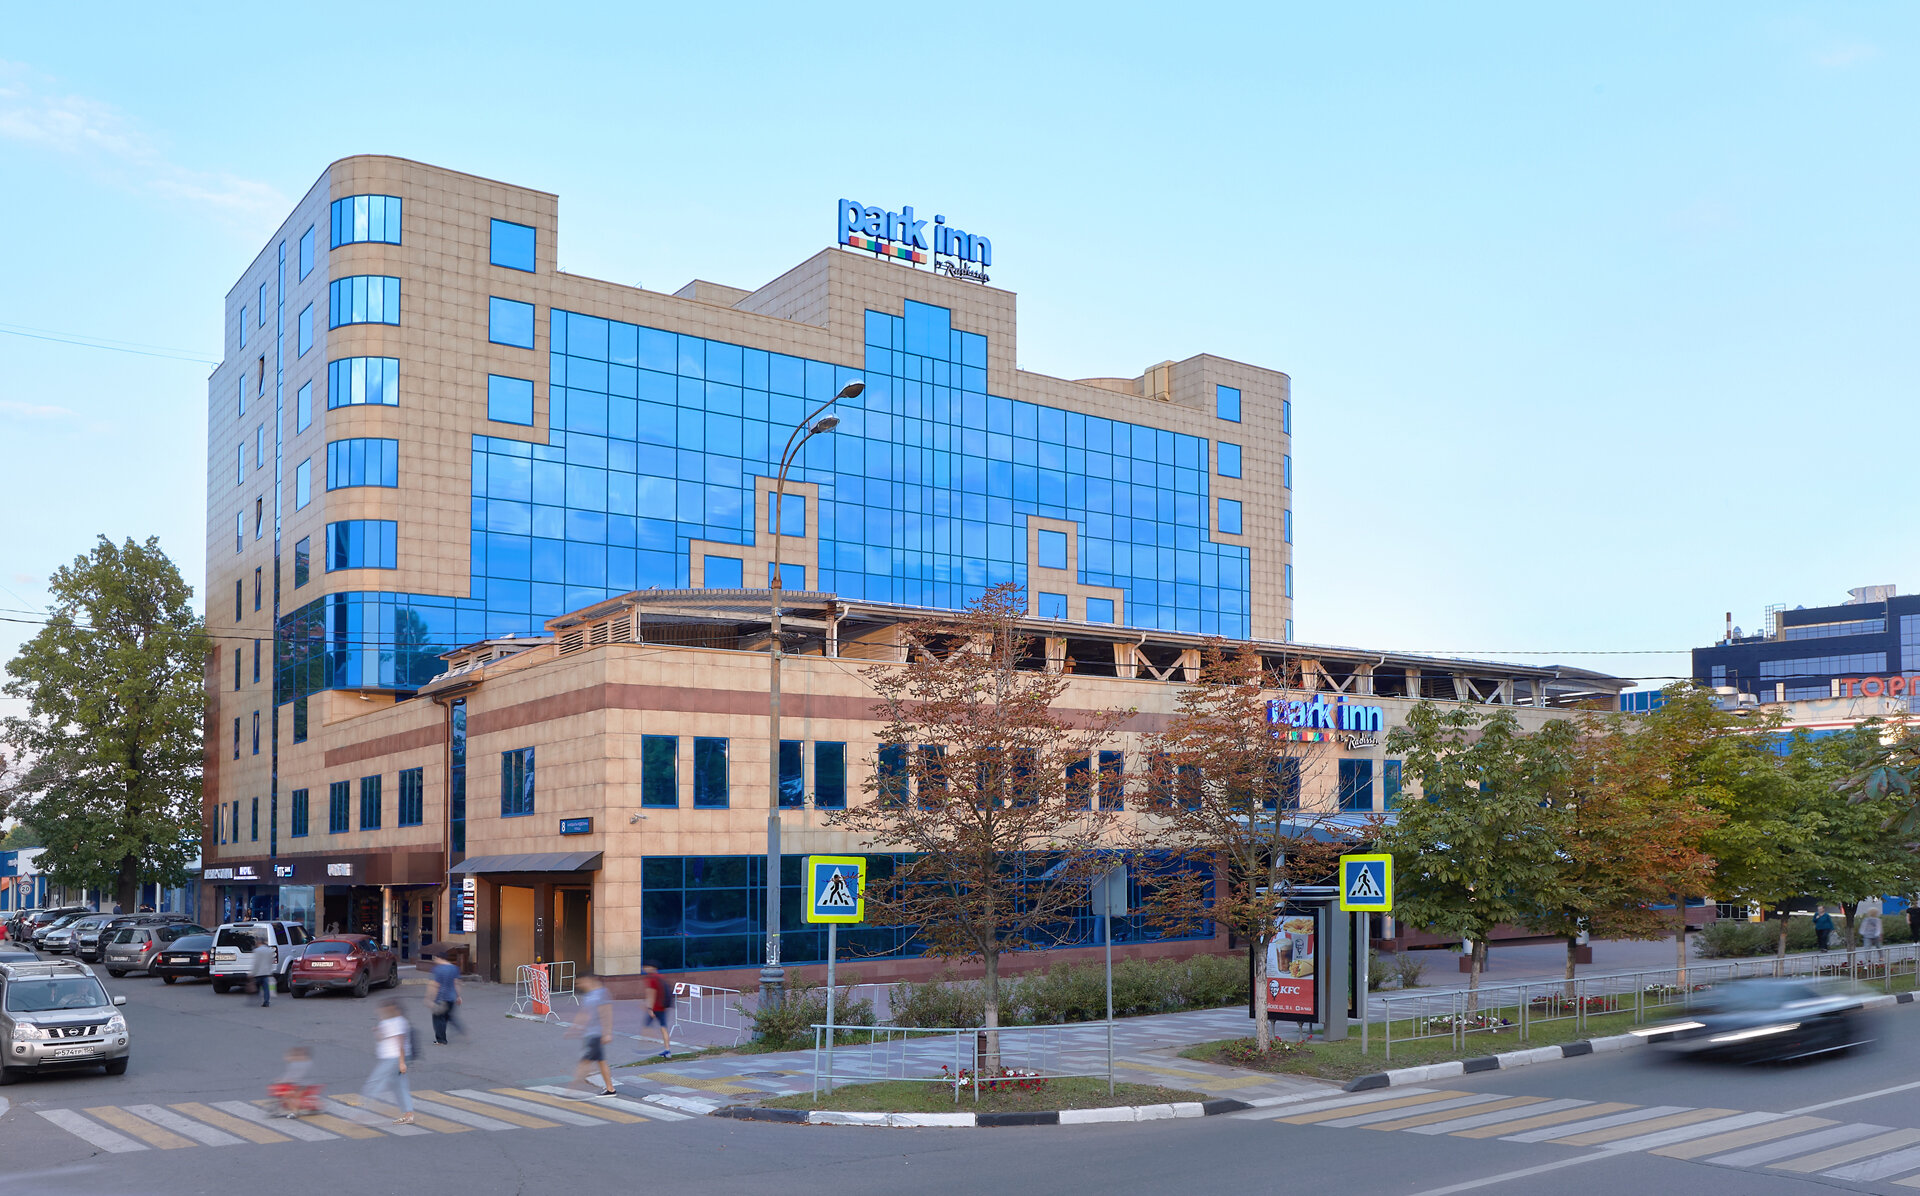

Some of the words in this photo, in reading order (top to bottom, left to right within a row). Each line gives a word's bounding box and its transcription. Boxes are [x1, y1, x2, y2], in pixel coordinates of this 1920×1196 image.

[838, 198, 928, 250] park
[934, 214, 992, 267] inn
[1337, 696, 1384, 732] inn
[561, 821, 566, 833] 8
[1280, 985, 1301, 995] KFC
